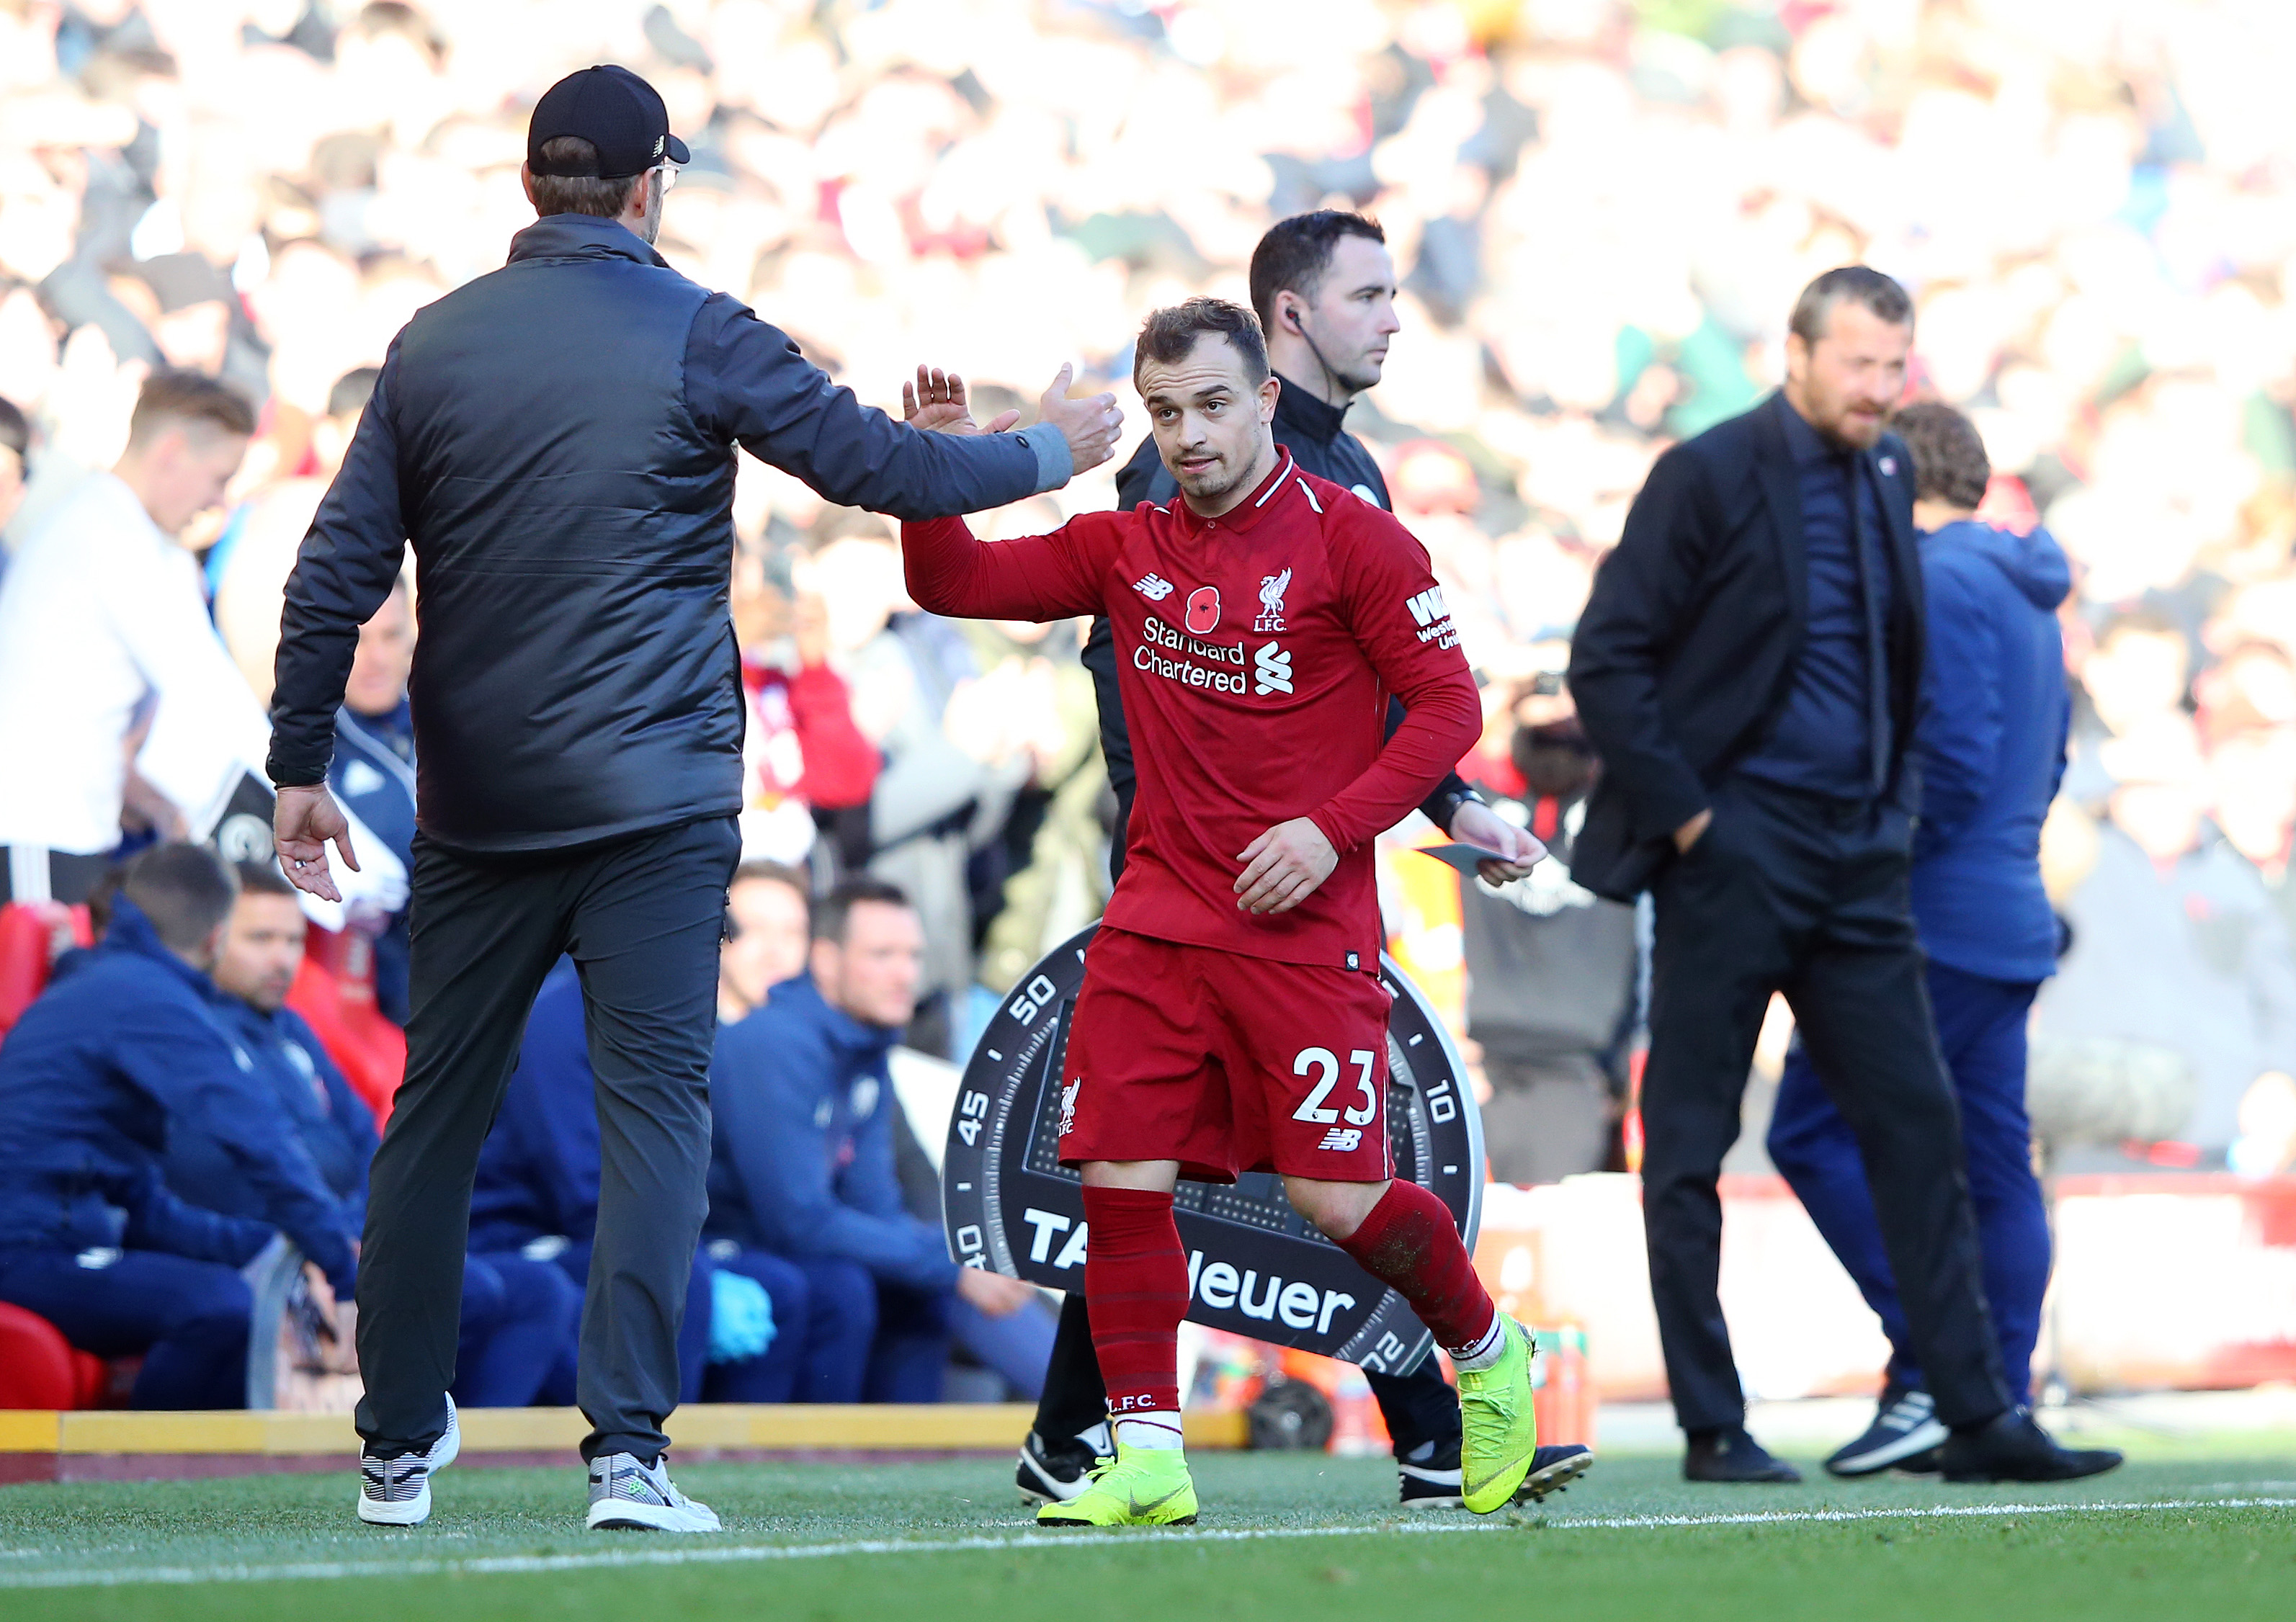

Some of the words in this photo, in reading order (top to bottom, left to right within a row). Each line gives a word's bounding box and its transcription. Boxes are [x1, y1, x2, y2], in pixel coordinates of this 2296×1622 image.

[1143, 617, 1246, 666] Standard
[1253, 618, 1287, 632] L.F.C.
[1416, 619, 1456, 643] Weste
[1133, 645, 1247, 694] Chartered
[1008, 974, 1057, 1026] 50
[1292, 1047, 1377, 1126] 23
[1425, 1079, 1457, 1124] 10
[957, 1089, 990, 1147] 45
[1023, 1207, 1089, 1271] TA
[1188, 1249, 1357, 1335] euer
[1109, 1394, 1156, 1413] L.F.C.
